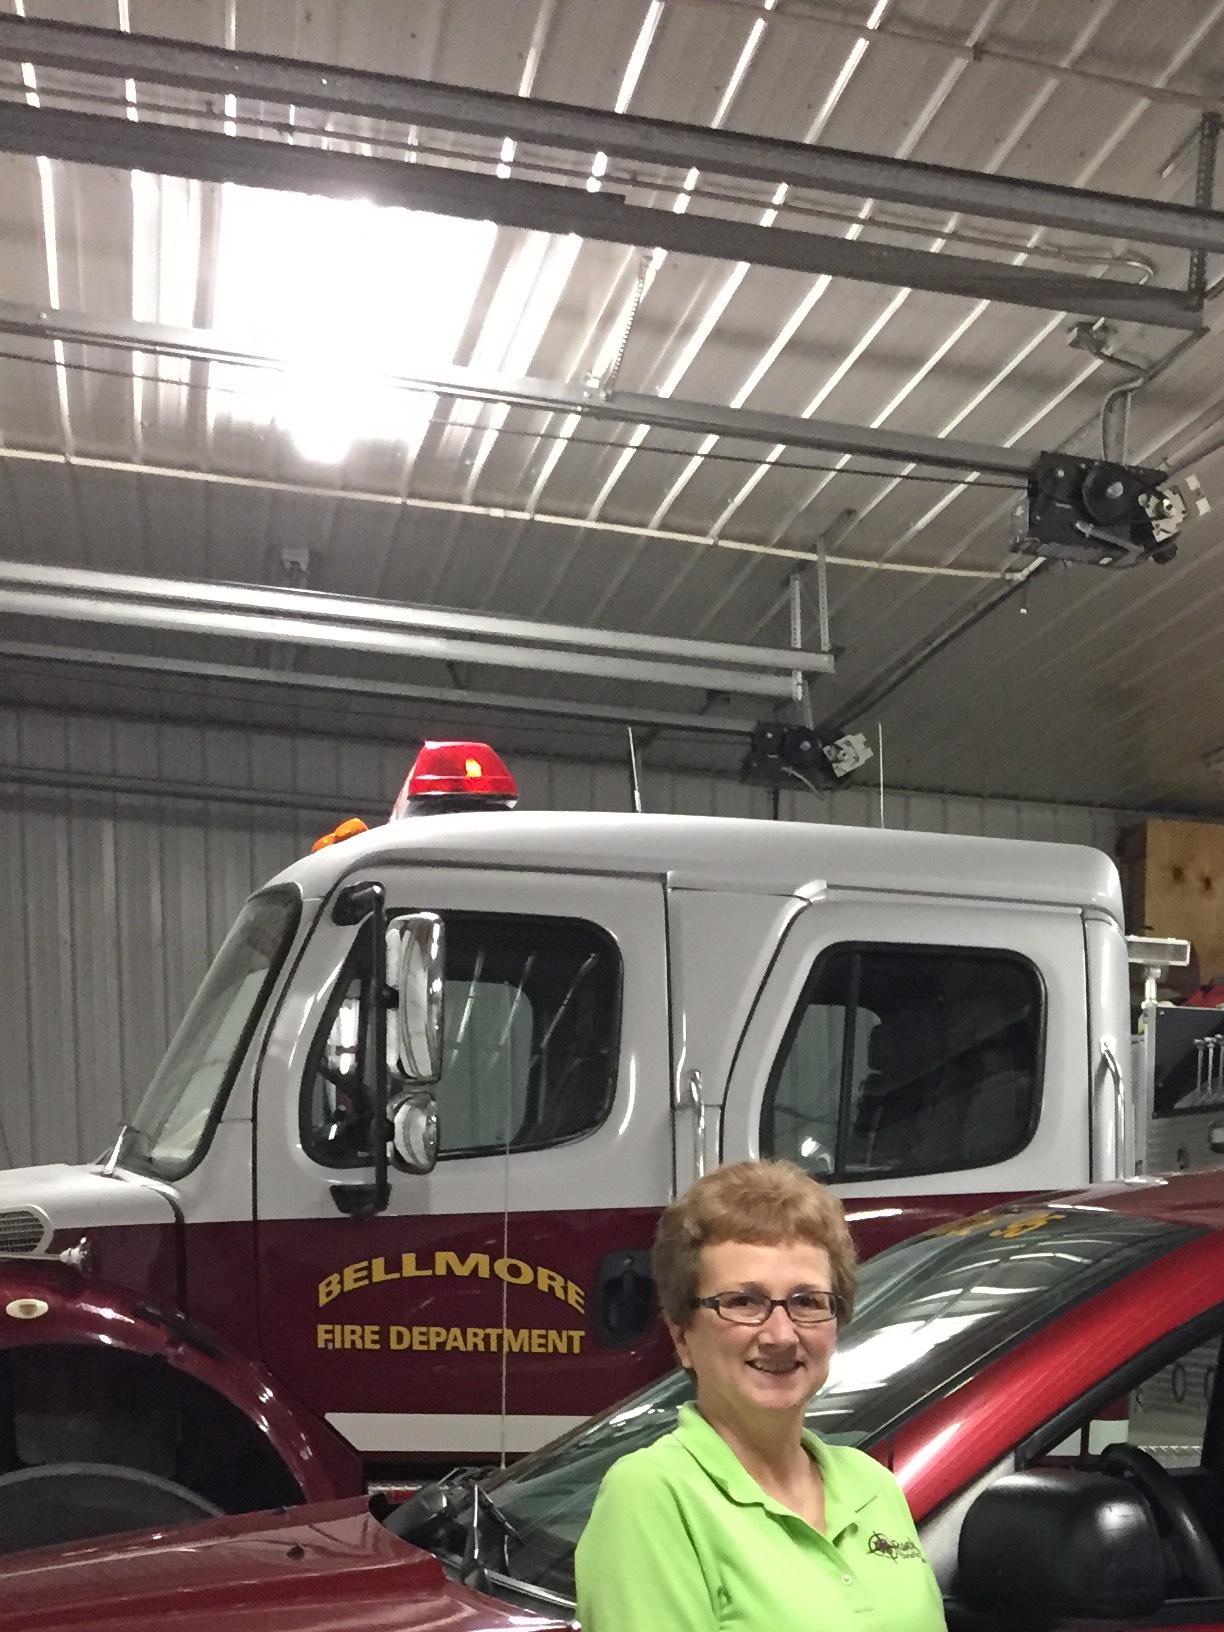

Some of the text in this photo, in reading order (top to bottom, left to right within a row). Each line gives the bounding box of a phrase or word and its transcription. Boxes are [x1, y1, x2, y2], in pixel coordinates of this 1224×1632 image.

[318, 1251, 586, 1315] BELLMORE
[317, 1324, 586, 1354] FIRE DEPARTMENT
